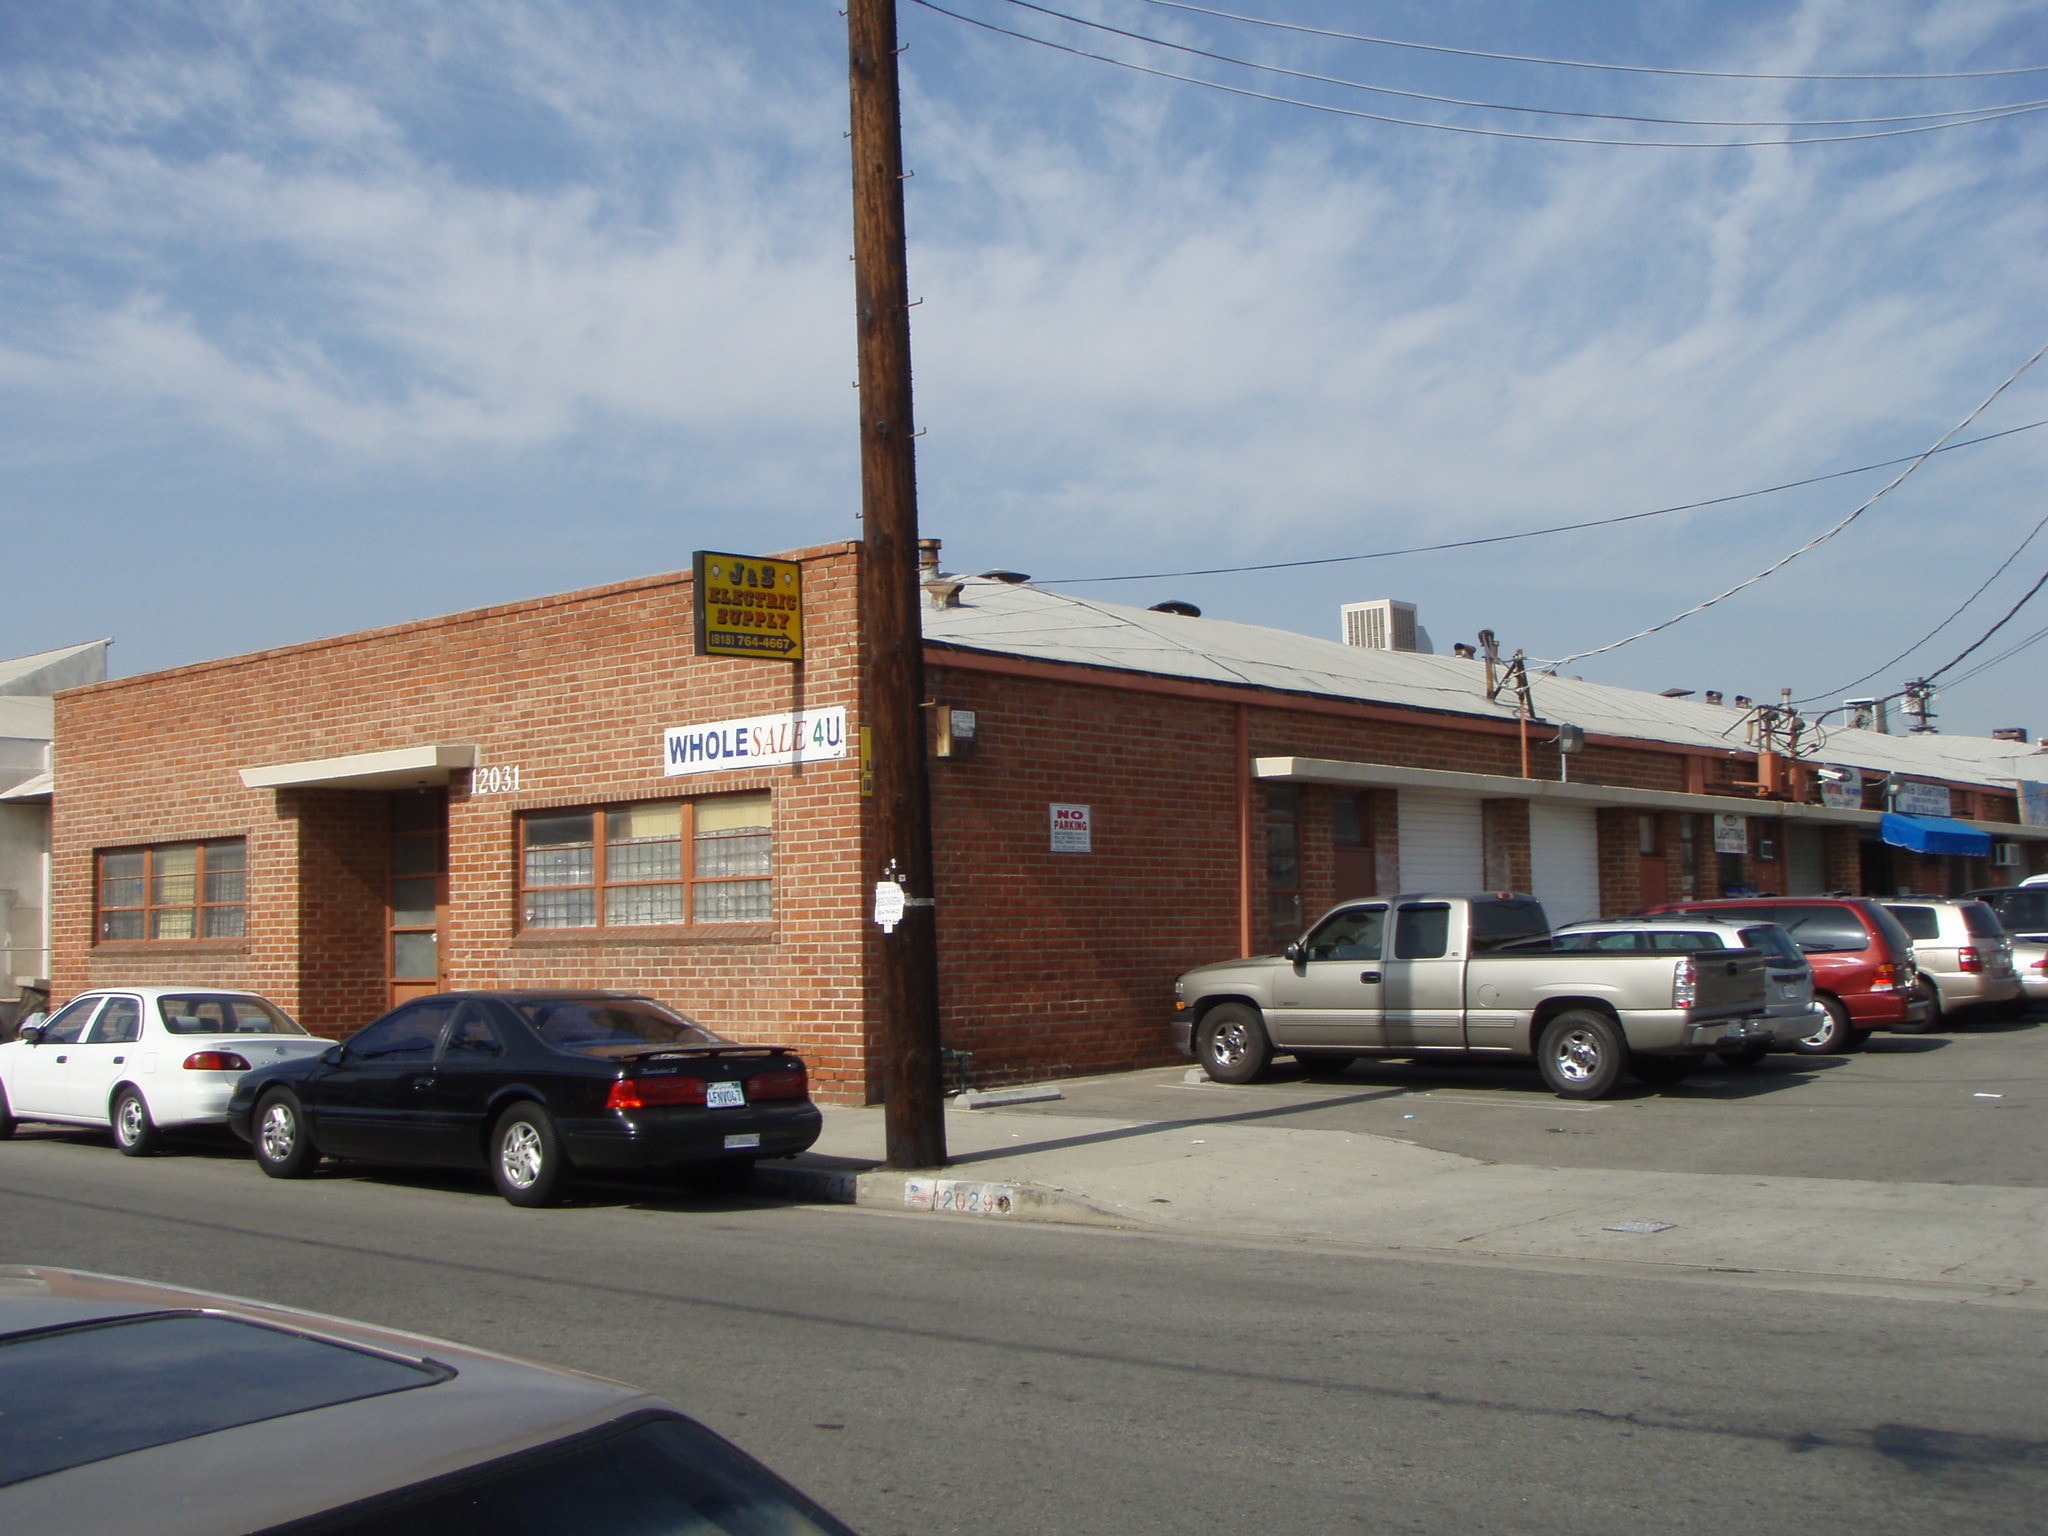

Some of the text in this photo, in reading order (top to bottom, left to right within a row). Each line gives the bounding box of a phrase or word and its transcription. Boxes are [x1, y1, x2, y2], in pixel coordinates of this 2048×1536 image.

[708, 587, 797, 610] ELECTRIC
[718, 608, 789, 629] SUPPLY
[711, 634, 735, 646] (818)
[471, 764, 521, 795] 12031
[1057, 810, 1084, 819] NO
[1054, 820, 1087, 831] PARKING
[708, 1090, 741, 1104] 4FNV047
